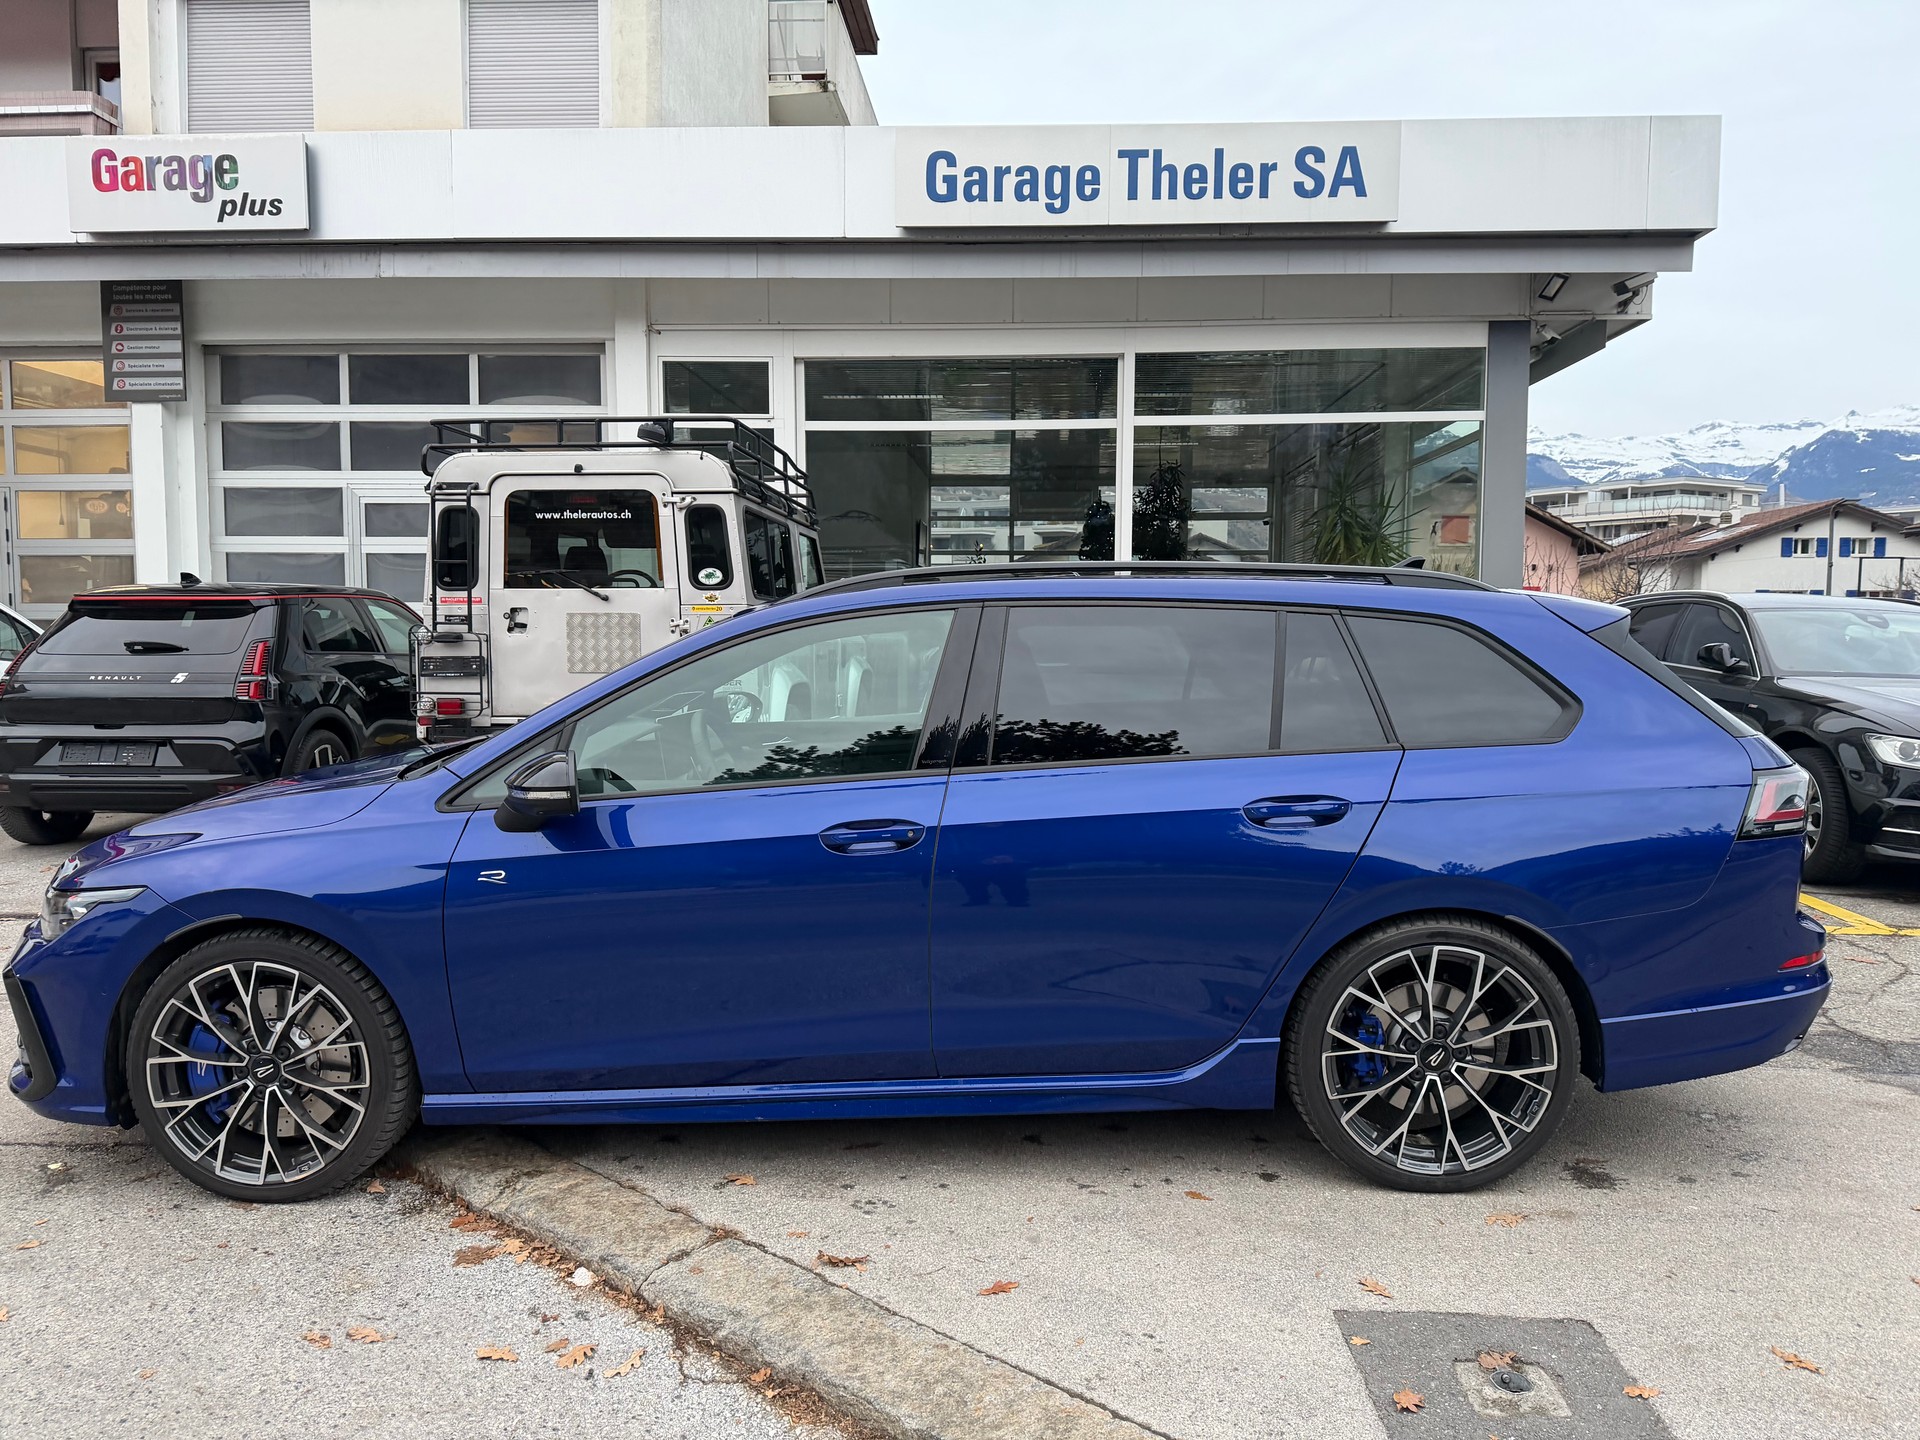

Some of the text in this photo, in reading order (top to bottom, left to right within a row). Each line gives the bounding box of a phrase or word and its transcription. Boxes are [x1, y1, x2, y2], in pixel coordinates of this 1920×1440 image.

[91, 148, 239, 203] Garage
[925, 145, 1368, 214] Garage Theler SA
[217, 192, 283, 223] plus
[535, 509, 632, 519] www.thelerautos.ch
